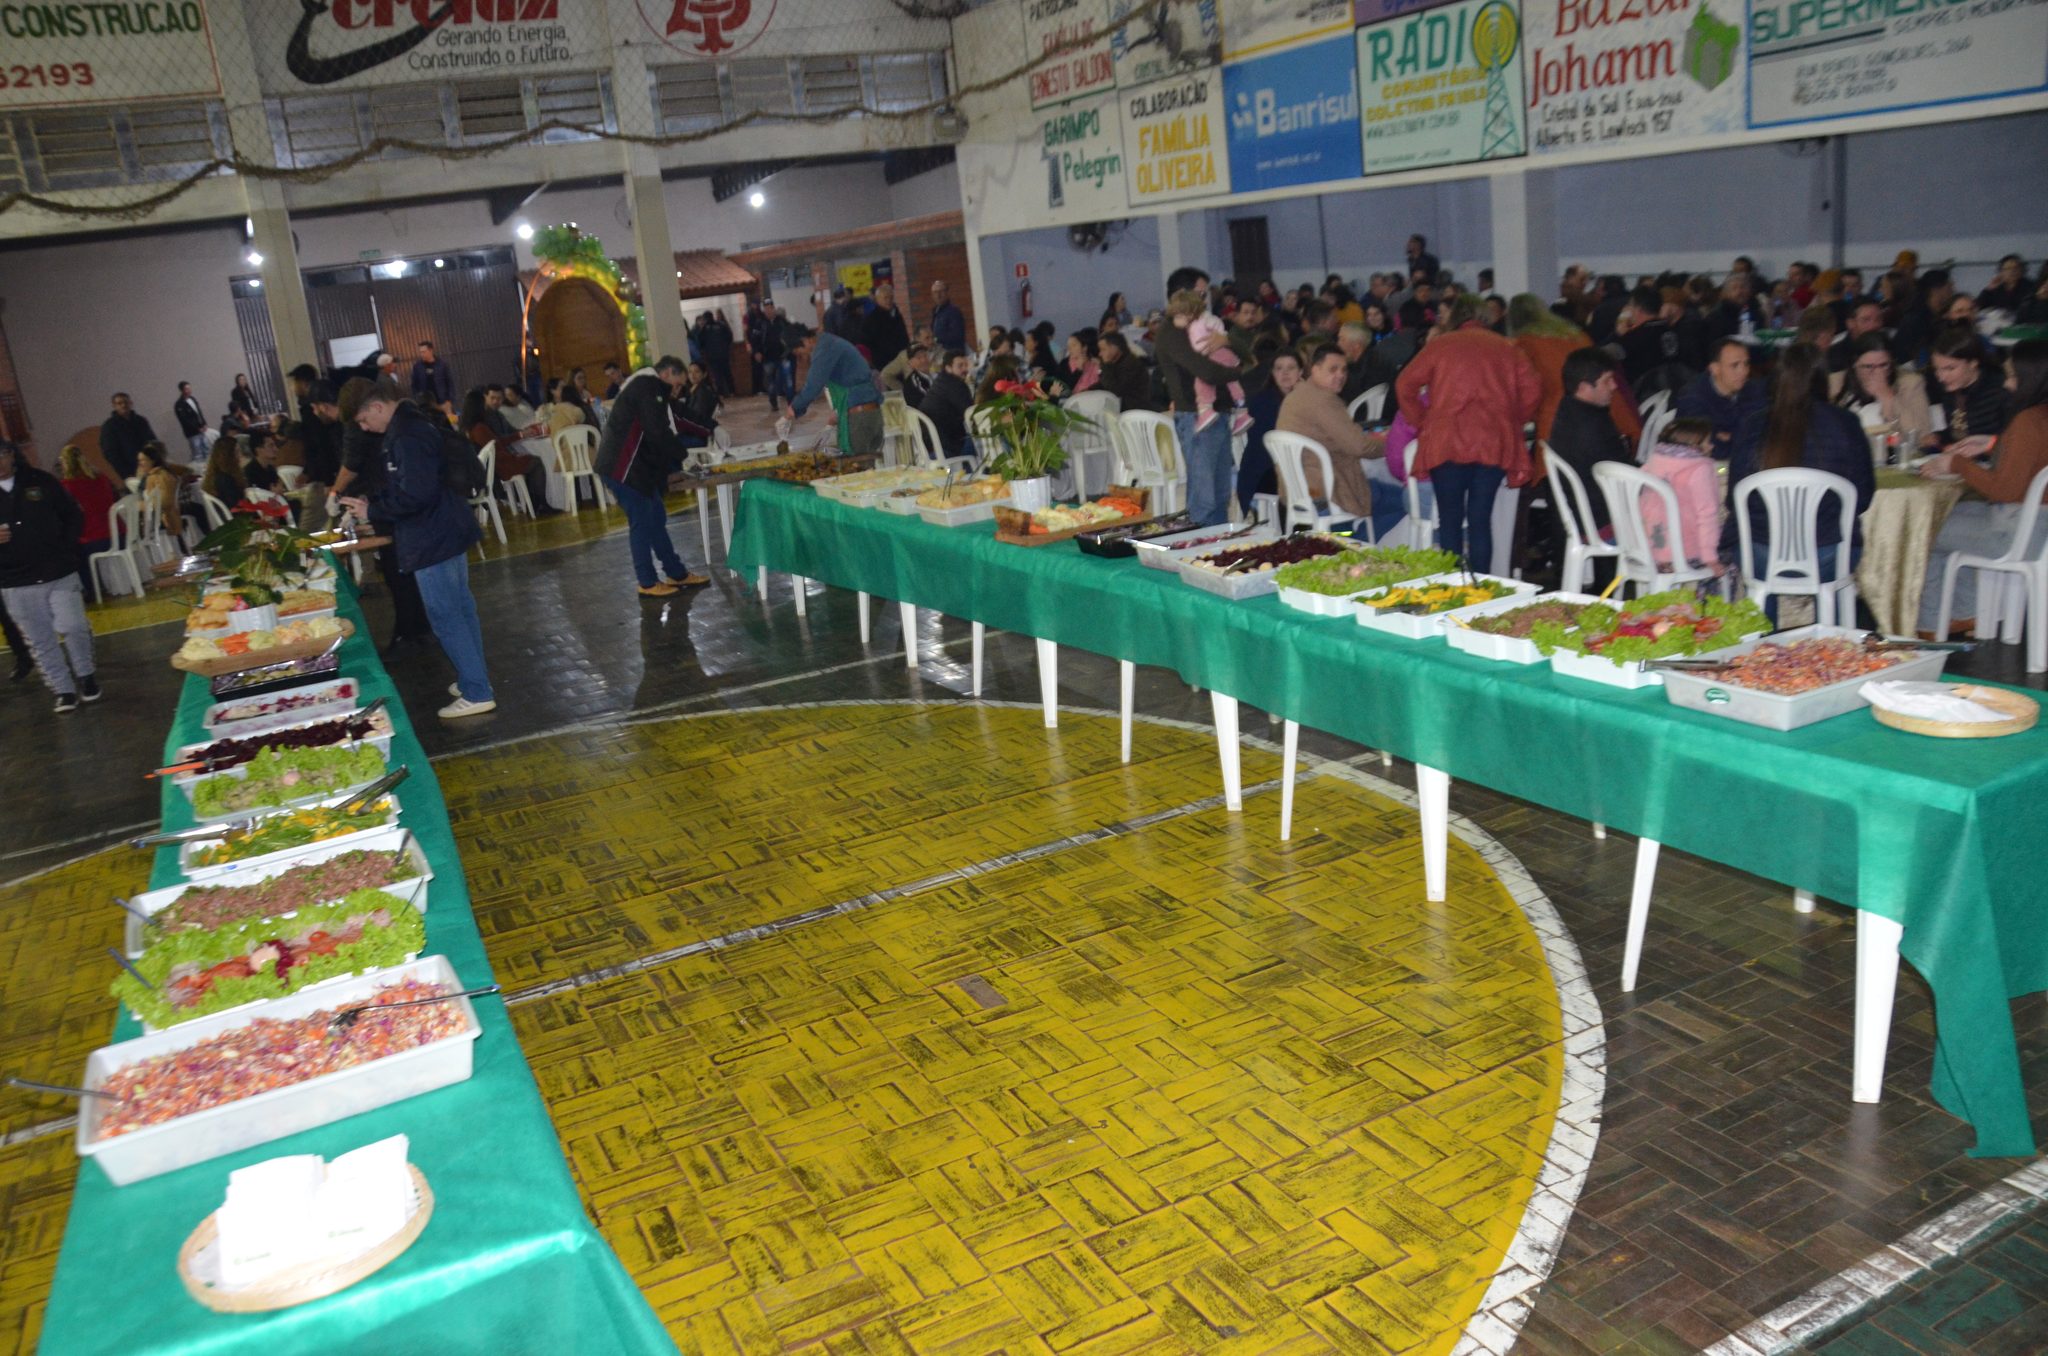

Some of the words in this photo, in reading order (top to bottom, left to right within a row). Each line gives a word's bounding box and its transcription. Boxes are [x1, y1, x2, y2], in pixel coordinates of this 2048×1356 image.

[436, 28, 502, 47] Gerando
[508, 25, 571, 47] Energia,
[408, 47, 502, 70] Construindo
[505, 52, 515, 64] o
[1529, 38, 1676, 107] Johann
[1130, 79, 1208, 120] COLABORAÇÃO
[1255, 68, 1358, 138] Banrisul
[1044, 108, 1100, 147] GARIMPO
[1139, 113, 1211, 159] FAMÍLIA
[1136, 150, 1217, 194] OLIVEIRA
